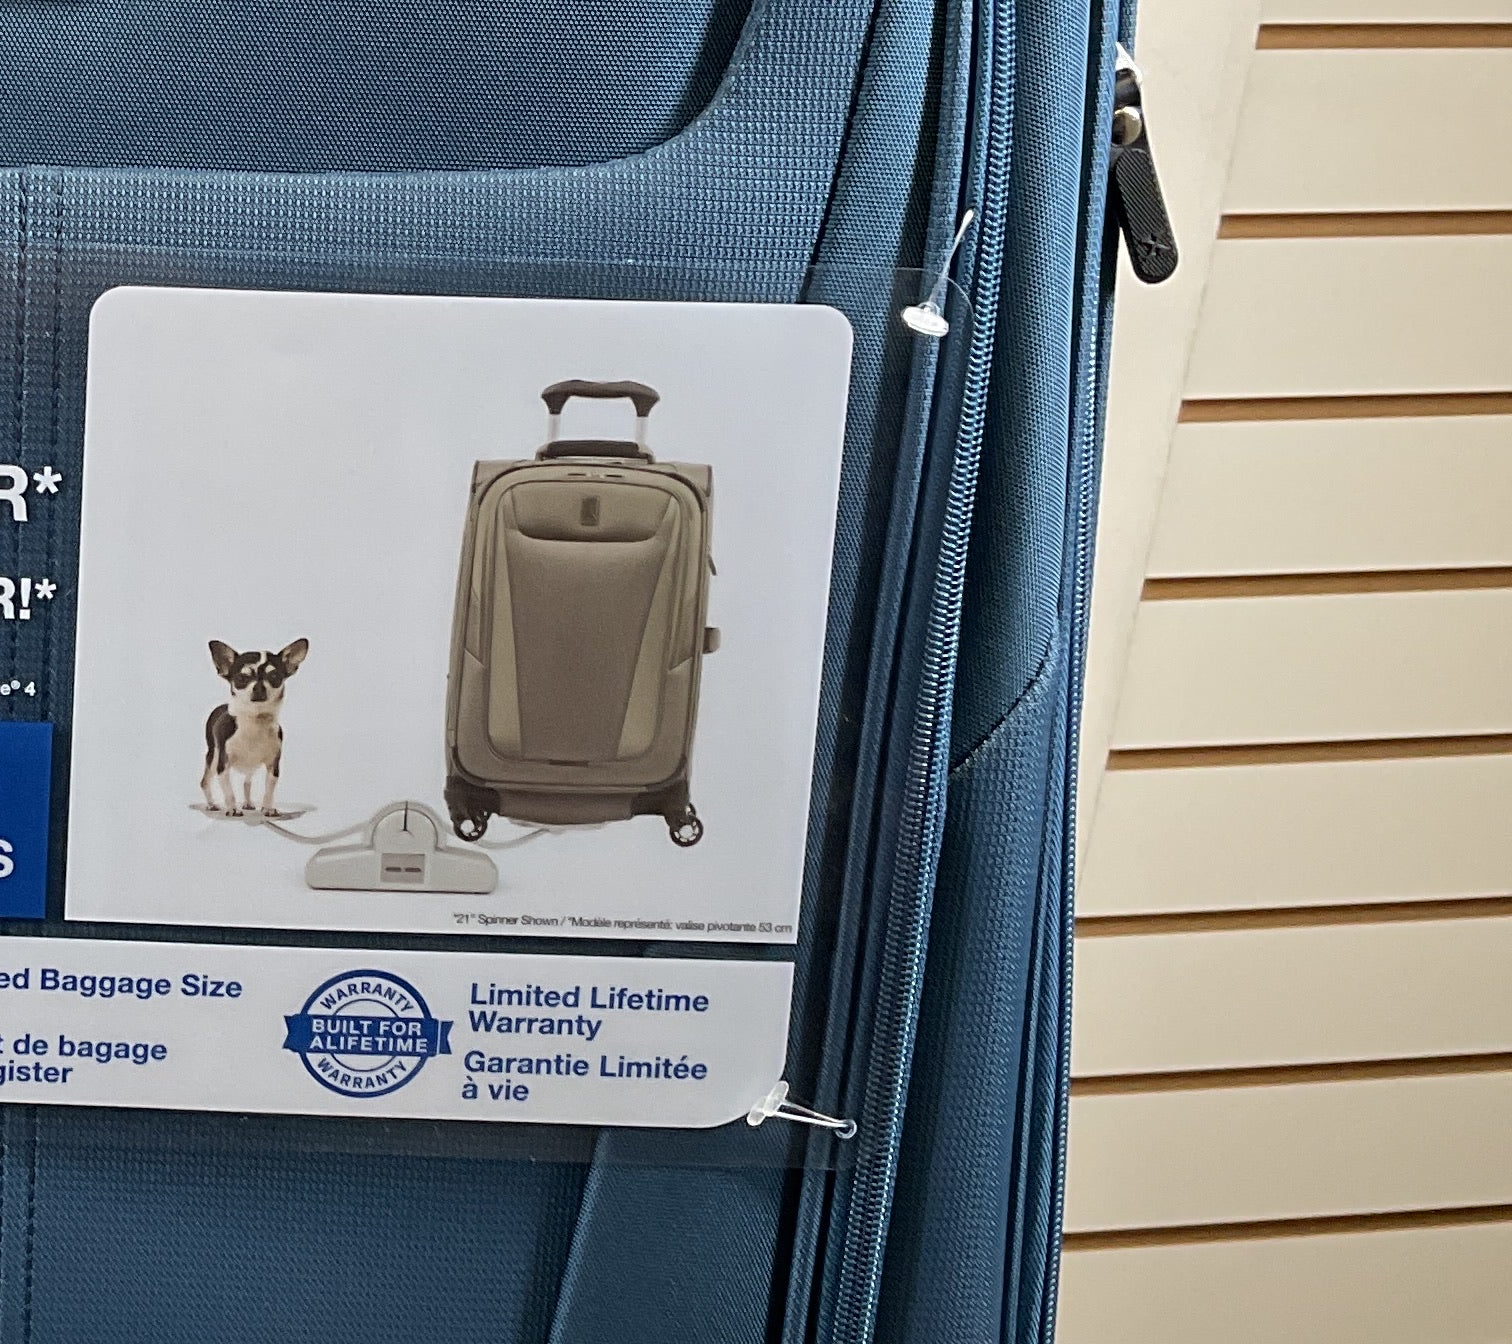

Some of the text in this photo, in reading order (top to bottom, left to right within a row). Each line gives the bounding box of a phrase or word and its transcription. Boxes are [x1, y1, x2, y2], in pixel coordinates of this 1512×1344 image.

[25, 682, 35, 696] 4
[478, 913, 518, 927] Spinner
[520, 914, 559, 927] Shown
[676, 918, 705, 931] valise
[707, 919, 756, 933] pivotante
[759, 921, 773, 933] 53
[774, 923, 793, 933] cm
[41, 969, 171, 999] Baggage
[181, 974, 242, 998] Size
[320, 982, 414, 1012] WARRANTY
[471, 983, 708, 1012] Limited Lifetime
[312, 1018, 422, 1036] BUILT FOR
[469, 1010, 602, 1041] Warranty
[13, 1034, 48, 1055] de
[59, 1035, 167, 1065] bagage
[317, 1056, 407, 1088] WARRANTY
[464, 1051, 707, 1080] Garantie Limitée
[462, 1076, 529, 1101] à vie
